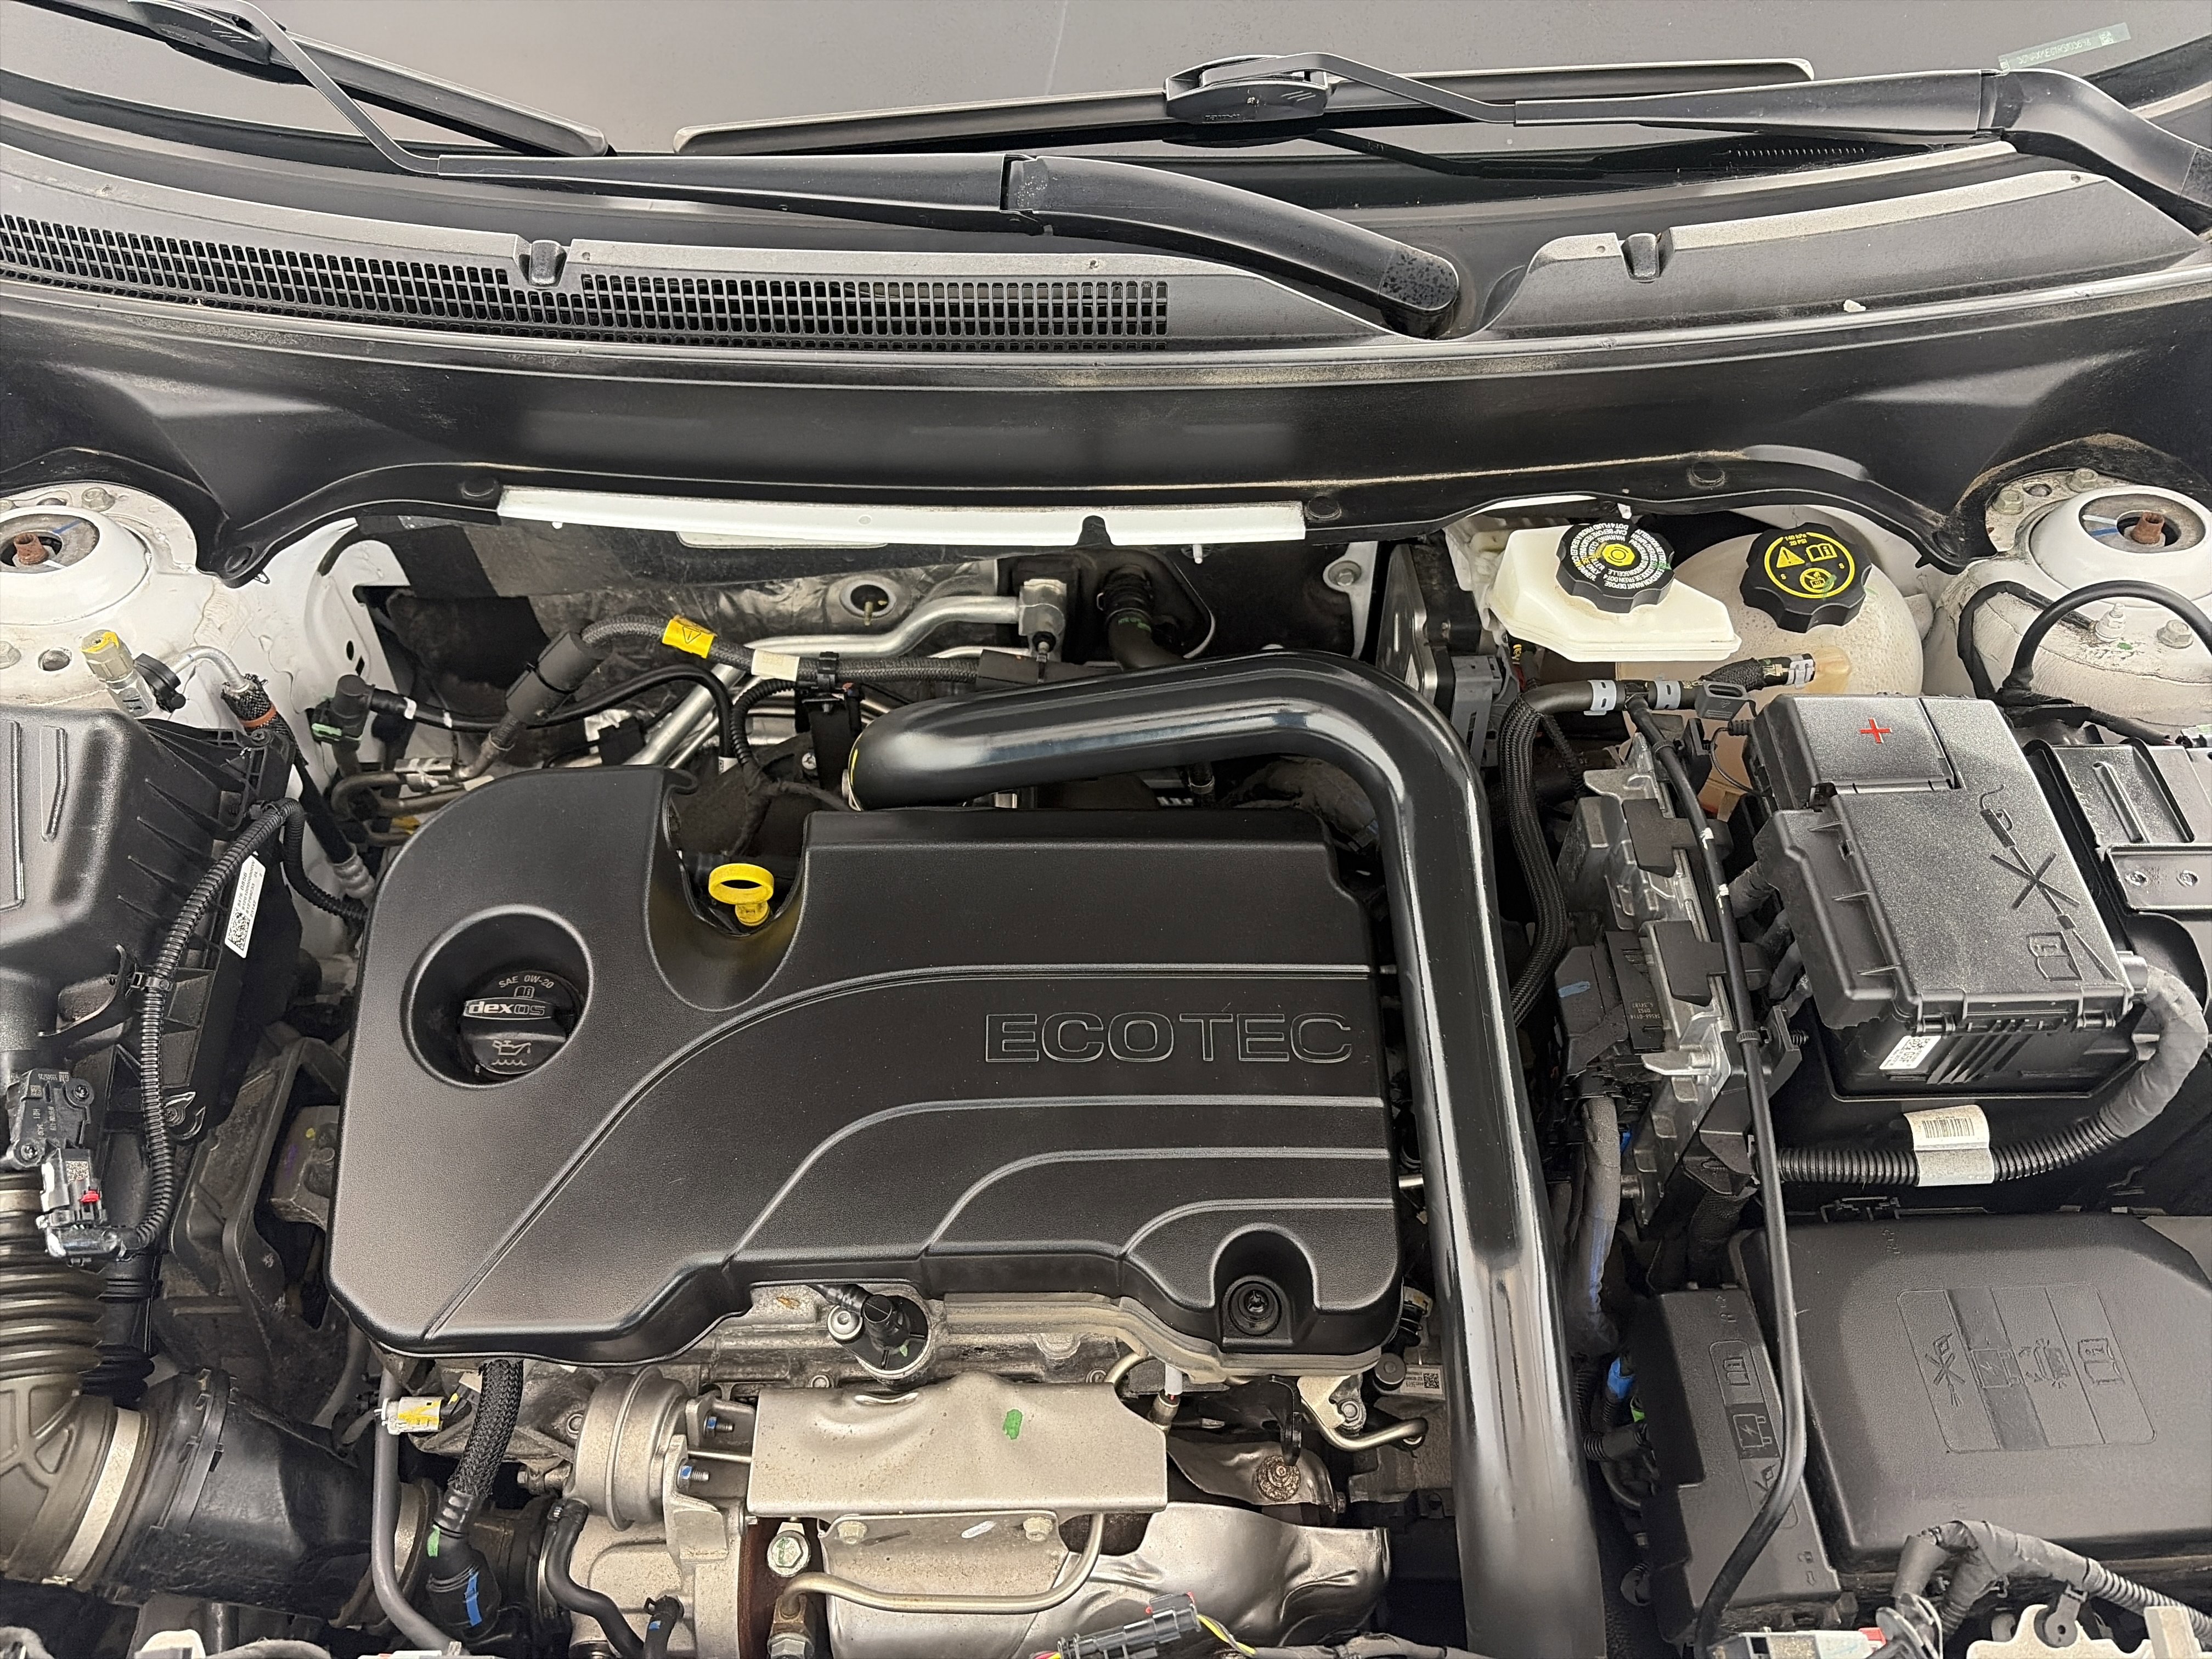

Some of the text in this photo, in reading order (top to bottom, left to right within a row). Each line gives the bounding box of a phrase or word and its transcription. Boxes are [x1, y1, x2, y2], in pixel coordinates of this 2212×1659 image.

[1577, 526, 1595, 538] FROM
[1592, 522, 1611, 531] FLUID
[1590, 528, 1614, 538] BEFORE
[1570, 538, 1583, 556] SEALED
[1585, 563, 1601, 575] ONLY
[1625, 580, 1645, 590] AVANT
[499, 974, 555, 989] SAE 0W-20
[469, 1001, 546, 1016] dexos
[985, 1012, 1352, 1063] ECOTEC
